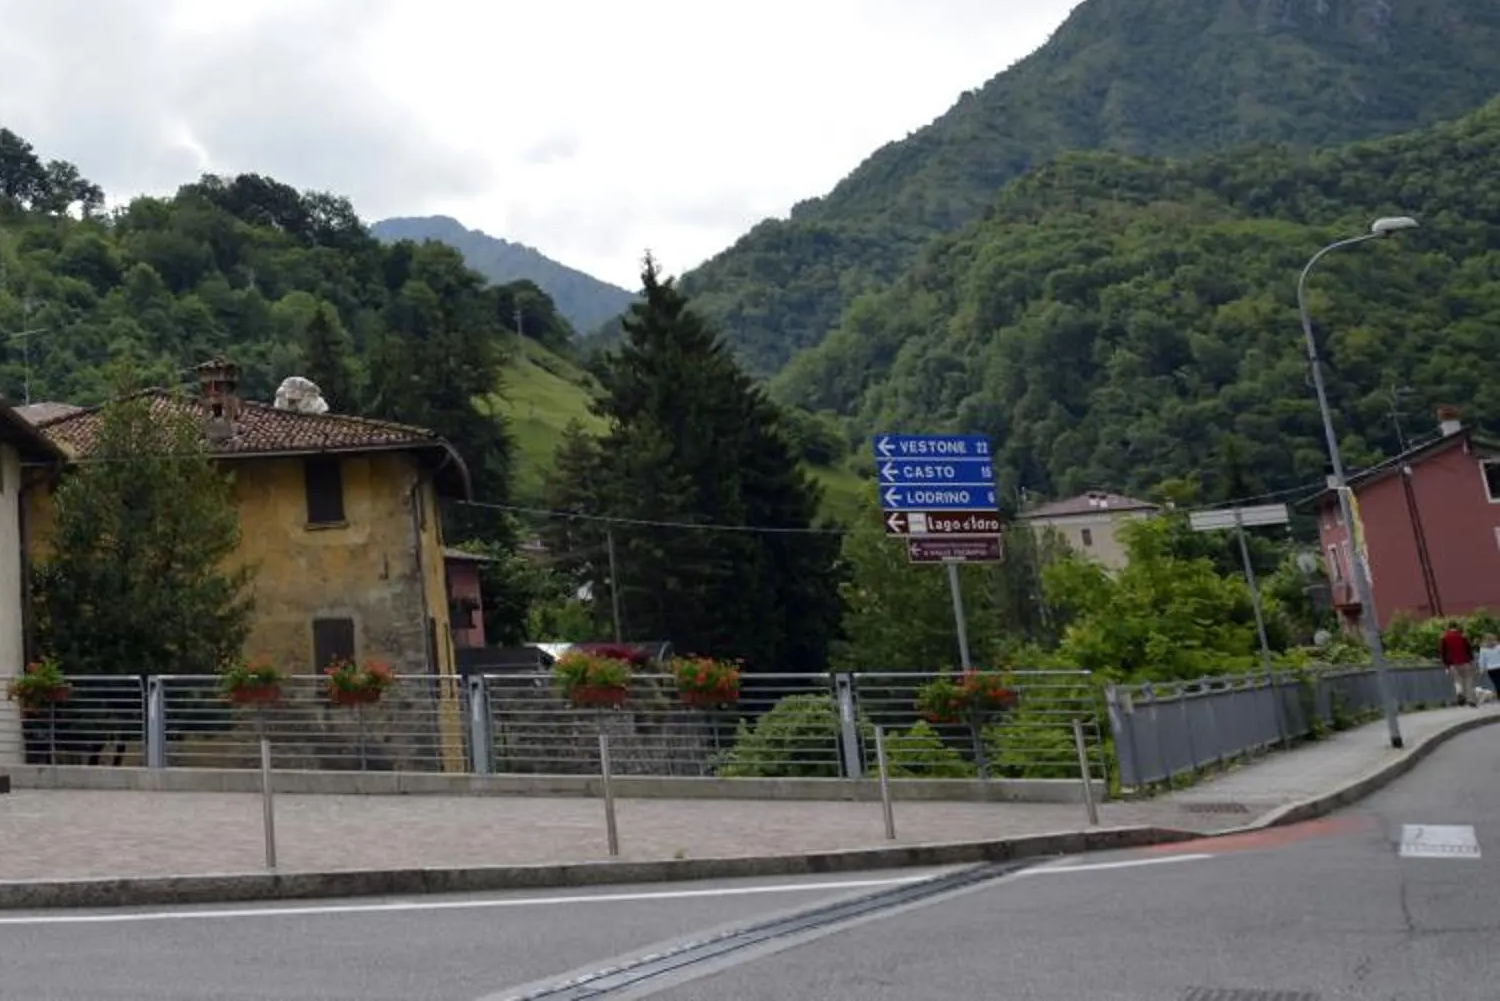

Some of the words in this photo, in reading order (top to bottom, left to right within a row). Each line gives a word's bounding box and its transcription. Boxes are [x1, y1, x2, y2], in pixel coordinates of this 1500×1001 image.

[900, 440, 967, 454] VESTONE
[903, 466, 955, 478] CASTO
[907, 491, 970, 504] LODRINO
